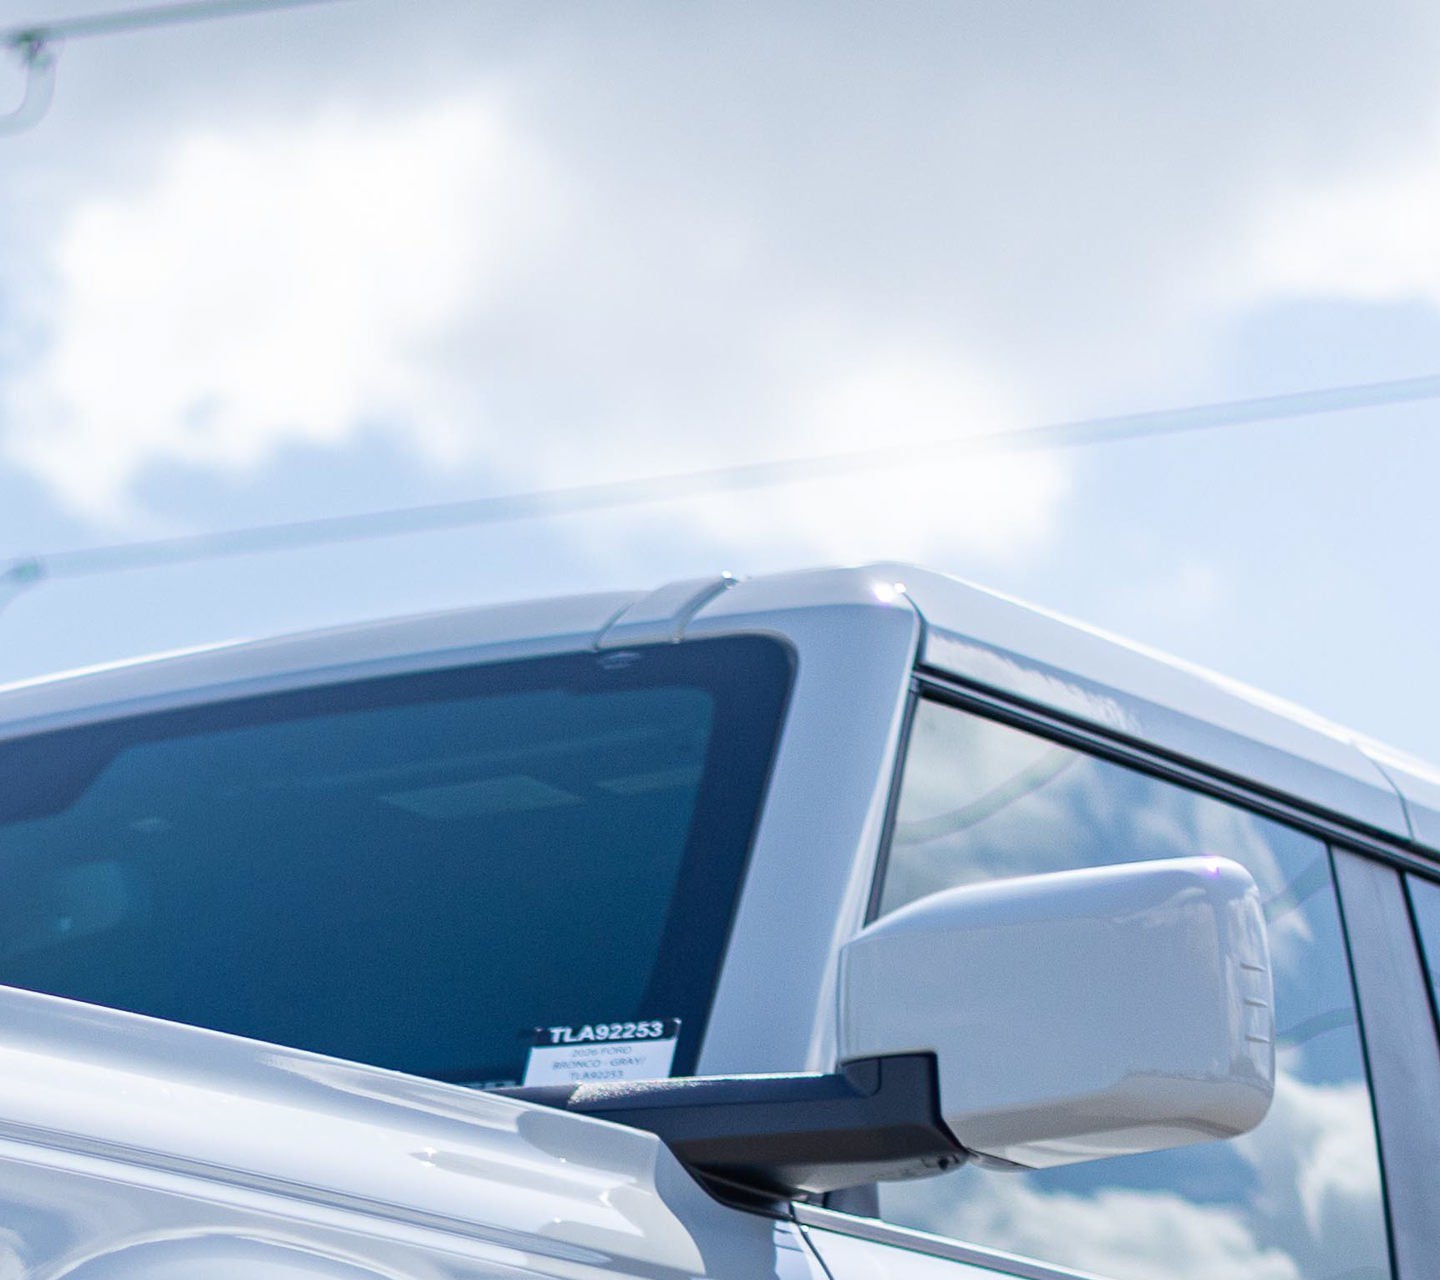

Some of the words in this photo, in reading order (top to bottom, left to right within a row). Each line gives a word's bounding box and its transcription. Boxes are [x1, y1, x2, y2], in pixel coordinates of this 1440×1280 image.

[549, 1021, 664, 1043] TLA92253
[601, 1046, 633, 1056] FORD
[552, 1059, 601, 1071] BRONCO
